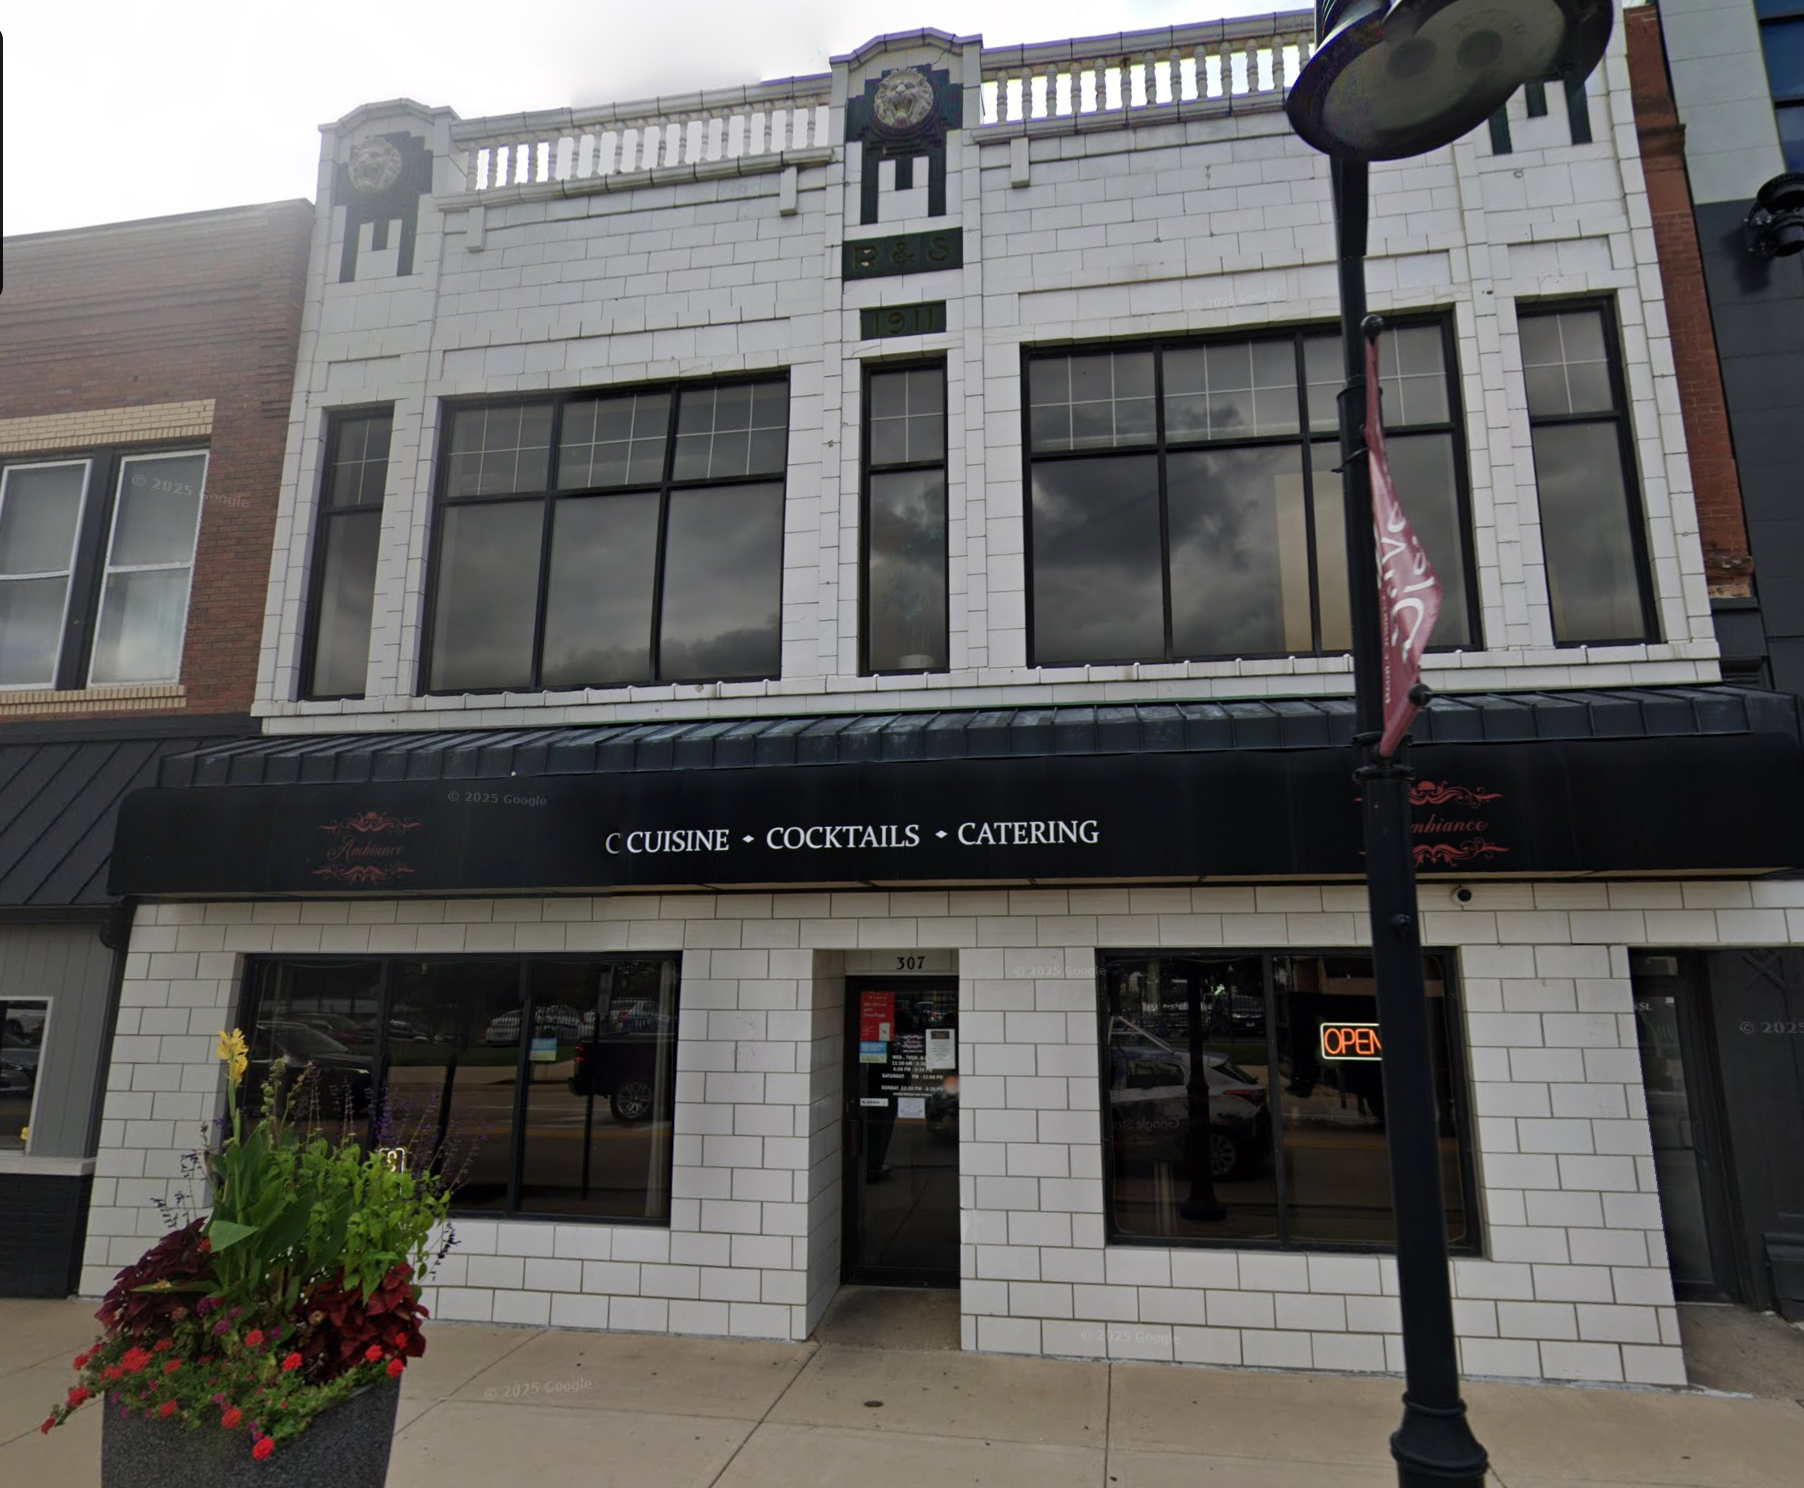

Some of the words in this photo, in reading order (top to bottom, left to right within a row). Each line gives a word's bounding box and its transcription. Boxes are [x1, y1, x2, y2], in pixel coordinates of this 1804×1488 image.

[892, 241, 915, 265] &
[927, 236, 951, 262] S
[873, 307, 935, 336] 1911
[626, 829, 730, 854] CUISINE
[766, 825, 921, 850] COCKTAILS
[957, 820, 1100, 846] CATERING
[1411, 812, 1488, 834] mbiance
[895, 955, 926, 971] 307
[1324, 1027, 1382, 1055] OPEN
